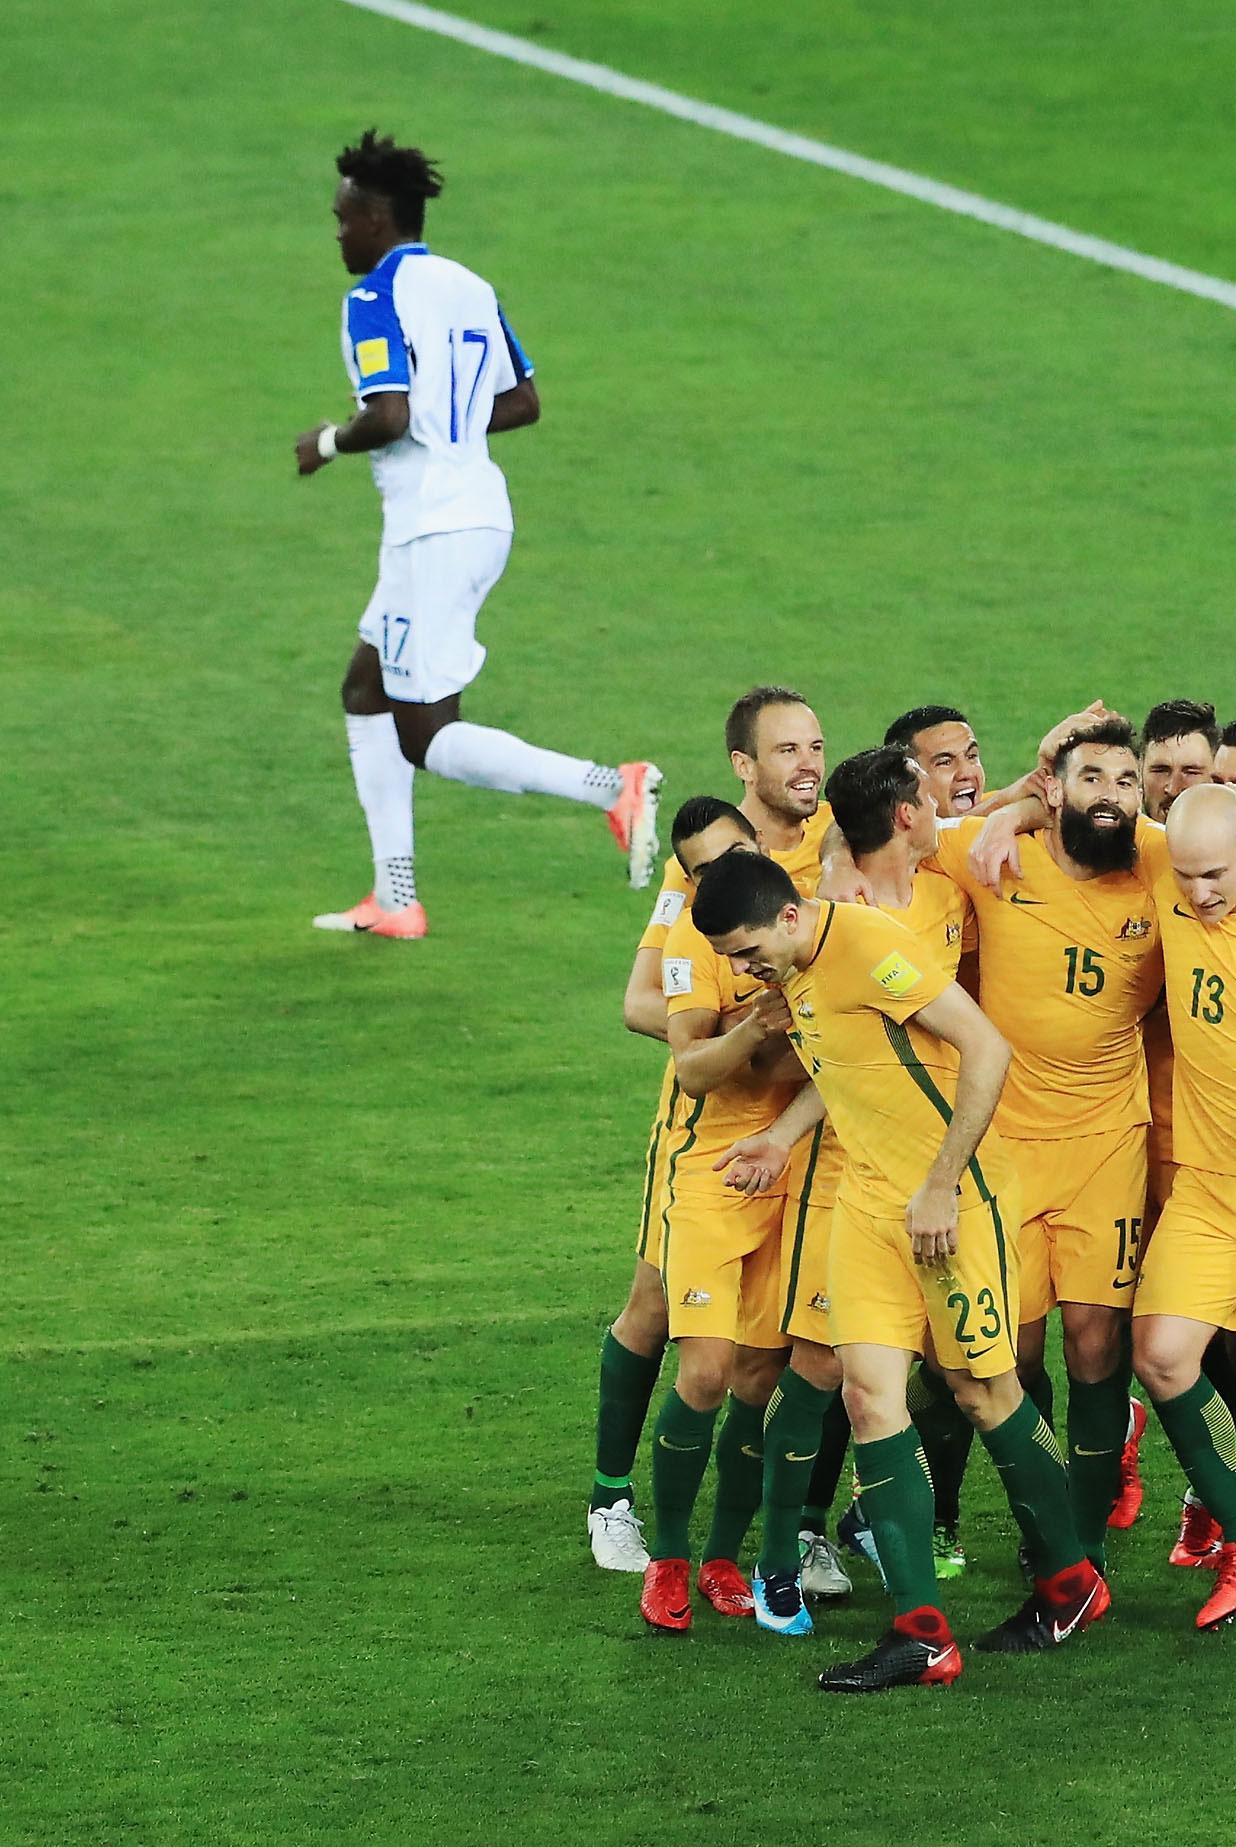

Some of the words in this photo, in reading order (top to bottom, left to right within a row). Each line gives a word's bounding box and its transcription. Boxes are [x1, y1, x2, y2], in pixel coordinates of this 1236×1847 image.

[449, 327, 488, 443] 17
[383, 614, 411, 662] 17
[1064, 946, 1105, 996] 15
[1191, 967, 1225, 1024] 13
[1114, 1217, 1142, 1271] 15
[947, 1287, 1001, 1343] 23
